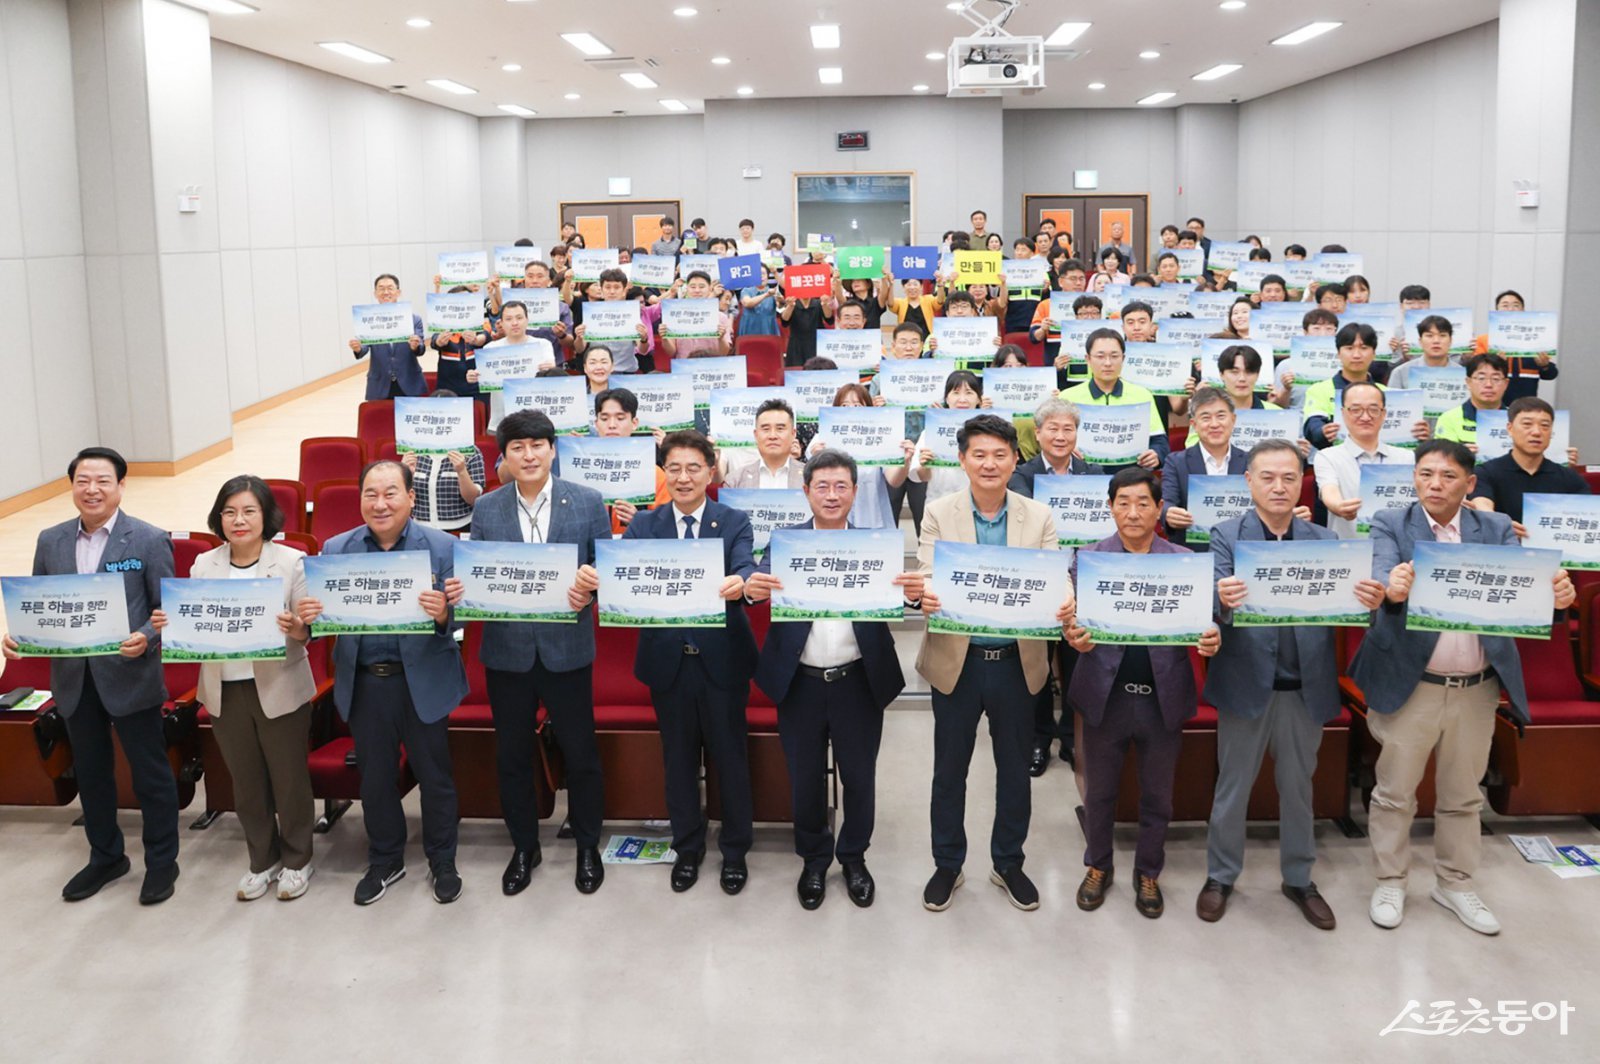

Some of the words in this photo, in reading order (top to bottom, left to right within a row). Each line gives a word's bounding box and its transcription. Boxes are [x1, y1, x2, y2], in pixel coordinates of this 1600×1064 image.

[849, 256, 873, 268] 광양
[903, 256, 926, 269] 하늘
[960, 262, 996, 273] 만들기
[730, 263, 751, 278] 맑고
[790, 276, 825, 288] 깨끗한
[1127, 356, 1143, 366] 푸른
[1145, 358, 1166, 367] 하늘을
[1156, 369, 1172, 377] 질주
[891, 376, 906, 384] 푸른
[908, 375, 929, 383] 하늘을
[921, 383, 936, 393] 질주
[994, 384, 1009, 392] 푸른
[1011, 384, 1032, 392] 하늘을
[516, 396, 532, 405] 푸른
[535, 396, 558, 404] 하늘을
[1024, 393, 1038, 401] 질주
[549, 406, 566, 415] 질주
[405, 415, 420, 424] 푸른
[423, 415, 445, 425] 하늘을
[436, 426, 452, 435] 질주
[831, 425, 849, 435] 푸른
[851, 425, 876, 435] 하늘을
[1082, 422, 1100, 433] 푸른
[1103, 424, 1128, 433] 하늘을
[1130, 424, 1141, 432] 향한
[865, 436, 883, 446] 질주
[1117, 433, 1134, 444] 질주
[572, 458, 591, 469] 푸른
[594, 459, 622, 469] 하늘을
[625, 460, 641, 469] 향한
[584, 473, 607, 481] 우리의
[610, 471, 630, 482] 질주
[1049, 497, 1070, 508] 푸른
[1073, 497, 1103, 509] 하늘을
[757, 510, 786, 520] 하늘을
[789, 512, 805, 520] 향한
[1090, 511, 1110, 522] 질주
[1539, 516, 1562, 528] 푸른
[1566, 518, 1598, 529] 하늘을
[1554, 533, 1580, 542] 우리의
[790, 558, 817, 572] 푸른
[822, 558, 859, 571] 하늘을
[862, 560, 884, 571] 향한
[471, 566, 496, 579] 푸른
[501, 567, 536, 580] 하늘을
[539, 570, 559, 581] 향한
[614, 567, 640, 580] 푸른
[644, 566, 681, 580] 하늘을
[684, 568, 705, 579] 향한
[1254, 568, 1282, 581] 푸른
[1287, 567, 1325, 580] 하늘을
[1329, 568, 1351, 579] 향한
[1431, 568, 1462, 583] 푸른
[1466, 570, 1507, 586] 하늘을
[1510, 576, 1534, 588] 향한
[325, 579, 350, 592] 푸른
[355, 578, 390, 590] 하늘을
[393, 578, 413, 589] 향한
[807, 577, 839, 587] 우리의
[843, 574, 870, 588] 질주
[951, 571, 979, 587] 푸른
[983, 574, 1021, 589] 하늘을
[1024, 579, 1046, 591] 향한
[487, 584, 517, 593] 우리의
[521, 583, 546, 595] 질주
[631, 585, 662, 596] 우리의
[666, 583, 692, 596] 질주
[1096, 581, 1125, 596] 푸른
[1129, 582, 1168, 596] 하늘을
[1172, 585, 1194, 596] 향한
[1271, 585, 1304, 595] 우리의
[1308, 582, 1336, 596] 질주
[343, 595, 372, 605] 우리의
[377, 592, 401, 605] 질주
[967, 592, 999, 604] 우리의
[1003, 590, 1031, 607] 질주
[1448, 588, 1483, 600] 우리의
[1487, 589, 1517, 603] 질주
[21, 602, 44, 614] 푸른
[48, 601, 84, 614] 하늘을
[87, 600, 108, 611] 향한
[179, 604, 203, 617] 푸른
[207, 604, 241, 618] 하늘을
[245, 606, 265, 616] 향한
[1113, 601, 1147, 612] 우리의
[1151, 600, 1179, 613] 질주
[38, 618, 66, 628] 우리의
[70, 613, 96, 628] 질주
[194, 622, 223, 632] 우리의
[228, 619, 253, 633] 질주
